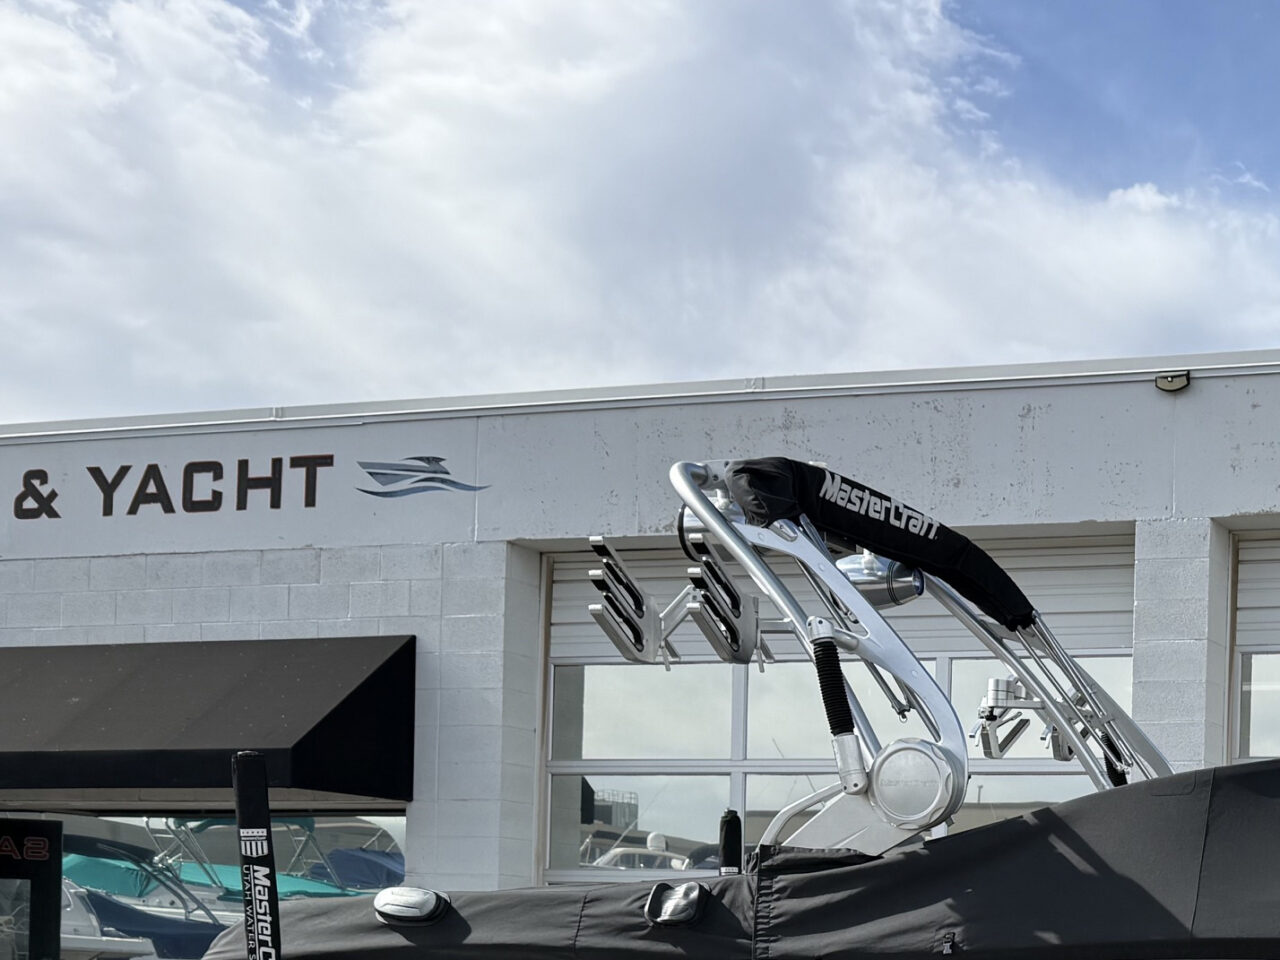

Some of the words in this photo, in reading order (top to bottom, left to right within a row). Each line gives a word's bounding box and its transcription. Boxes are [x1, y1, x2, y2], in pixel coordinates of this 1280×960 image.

[13, 469, 62, 519] &
[86, 454, 335, 517] YACHT
[819, 469, 940, 540] MasterCraft
[242, 864, 252, 900] UTAH
[246, 905, 256, 949] WATER
